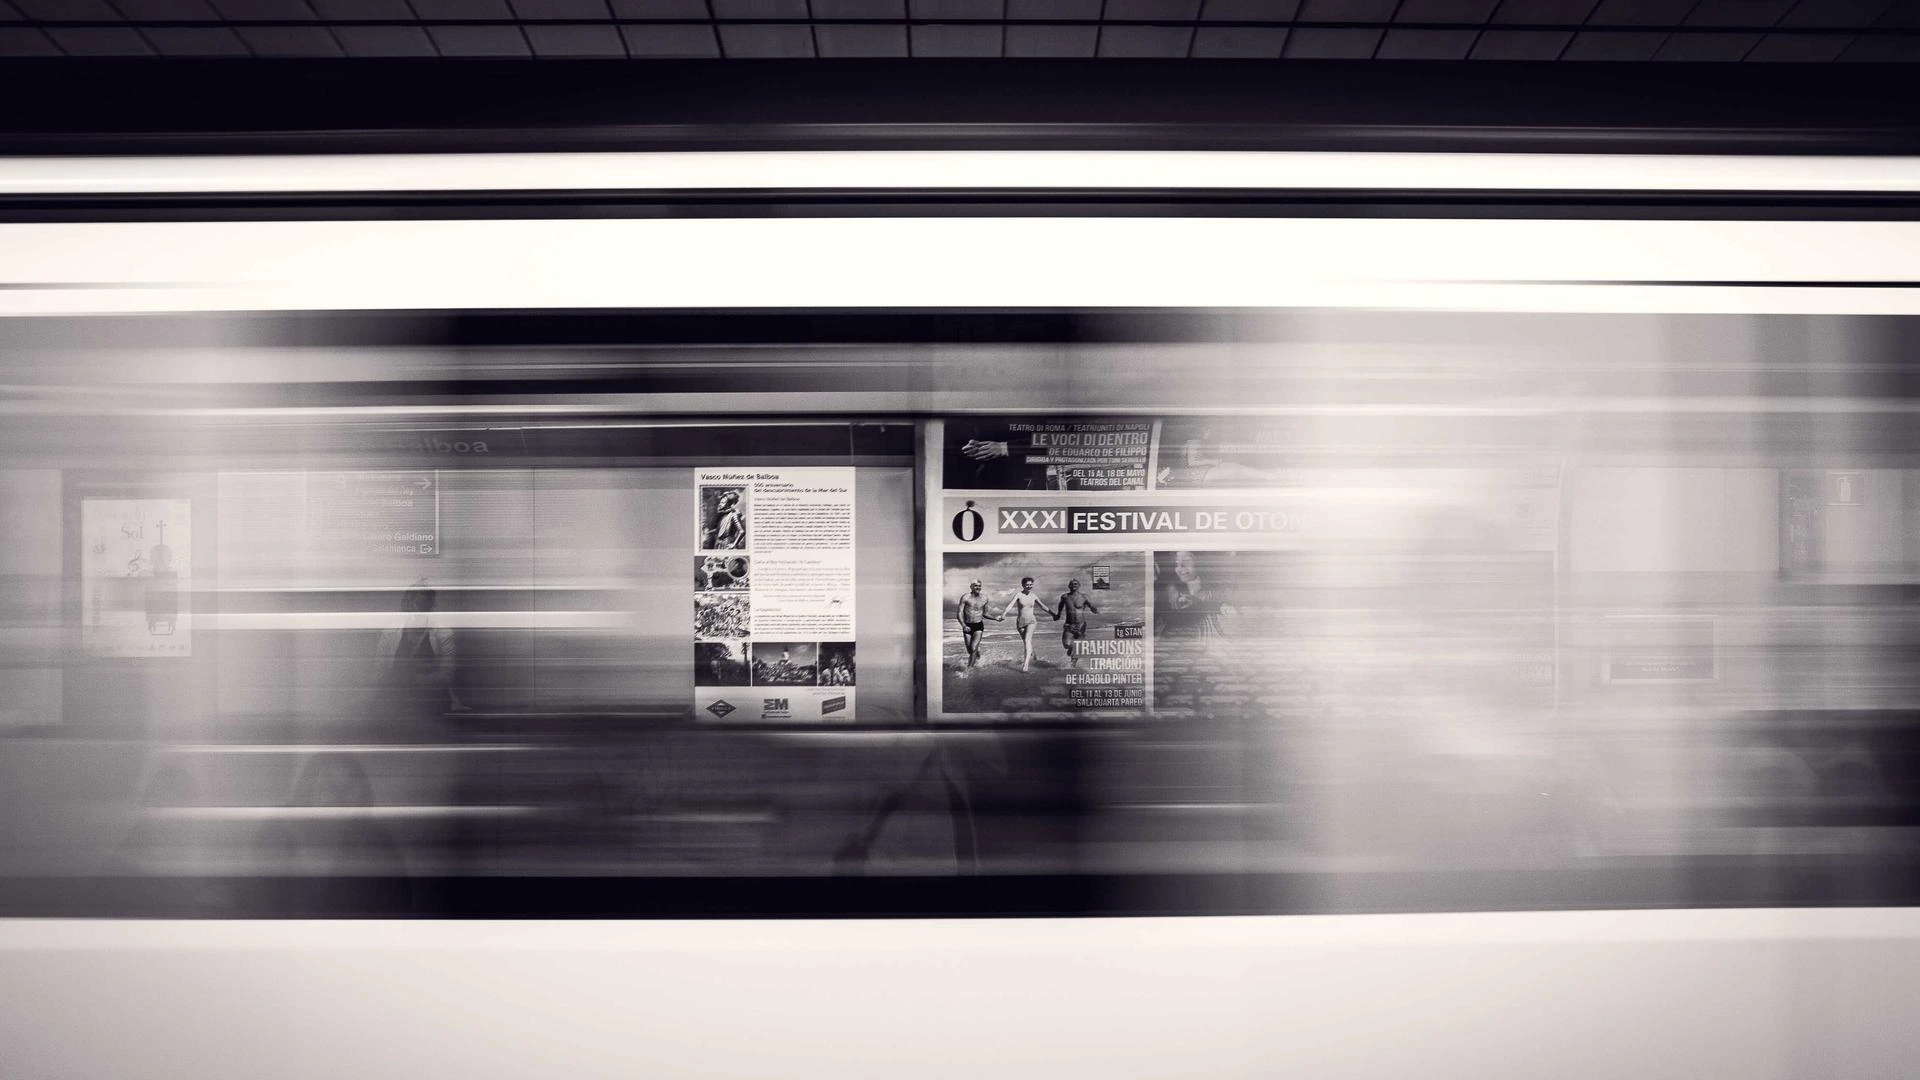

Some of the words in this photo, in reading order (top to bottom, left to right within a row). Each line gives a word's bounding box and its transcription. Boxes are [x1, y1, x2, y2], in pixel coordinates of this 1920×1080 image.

[1032, 434, 1048, 446] LE
[1051, 433, 1080, 446] VOCI
[1083, 433, 1097, 446] DI
[1098, 432, 1148, 446] DENTRO
[1049, 448, 1059, 456] DE
[1103, 448, 1113, 456] DE
[1115, 447, 1147, 456] FILIPPO
[1080, 478, 1108, 486] TEATROS
[1109, 478, 1122, 486] DEL
[1123, 477, 1144, 485] CANAL
[1000, 510, 1066, 529] XXXI
[1073, 511, 1188, 531] FESTIVAL
[1196, 511, 1228, 530] DE
[394, 532, 434, 541] Galdiano
[1125, 627, 1142, 636] STAN
[1074, 640, 1143, 655] TRAHISONS
[1066, 674, 1077, 684] DE
[1079, 674, 1111, 684] HAROLD
[1113, 674, 1142, 684] PINTER
[1071, 690, 1084, 698] DEL
[1094, 690, 1102, 698] AL
[1104, 690, 1113, 698] 13
[1114, 690, 1123, 698] DE
[1124, 689, 1143, 697] JUNIO
[1094, 698, 1120, 706] CUARTA
